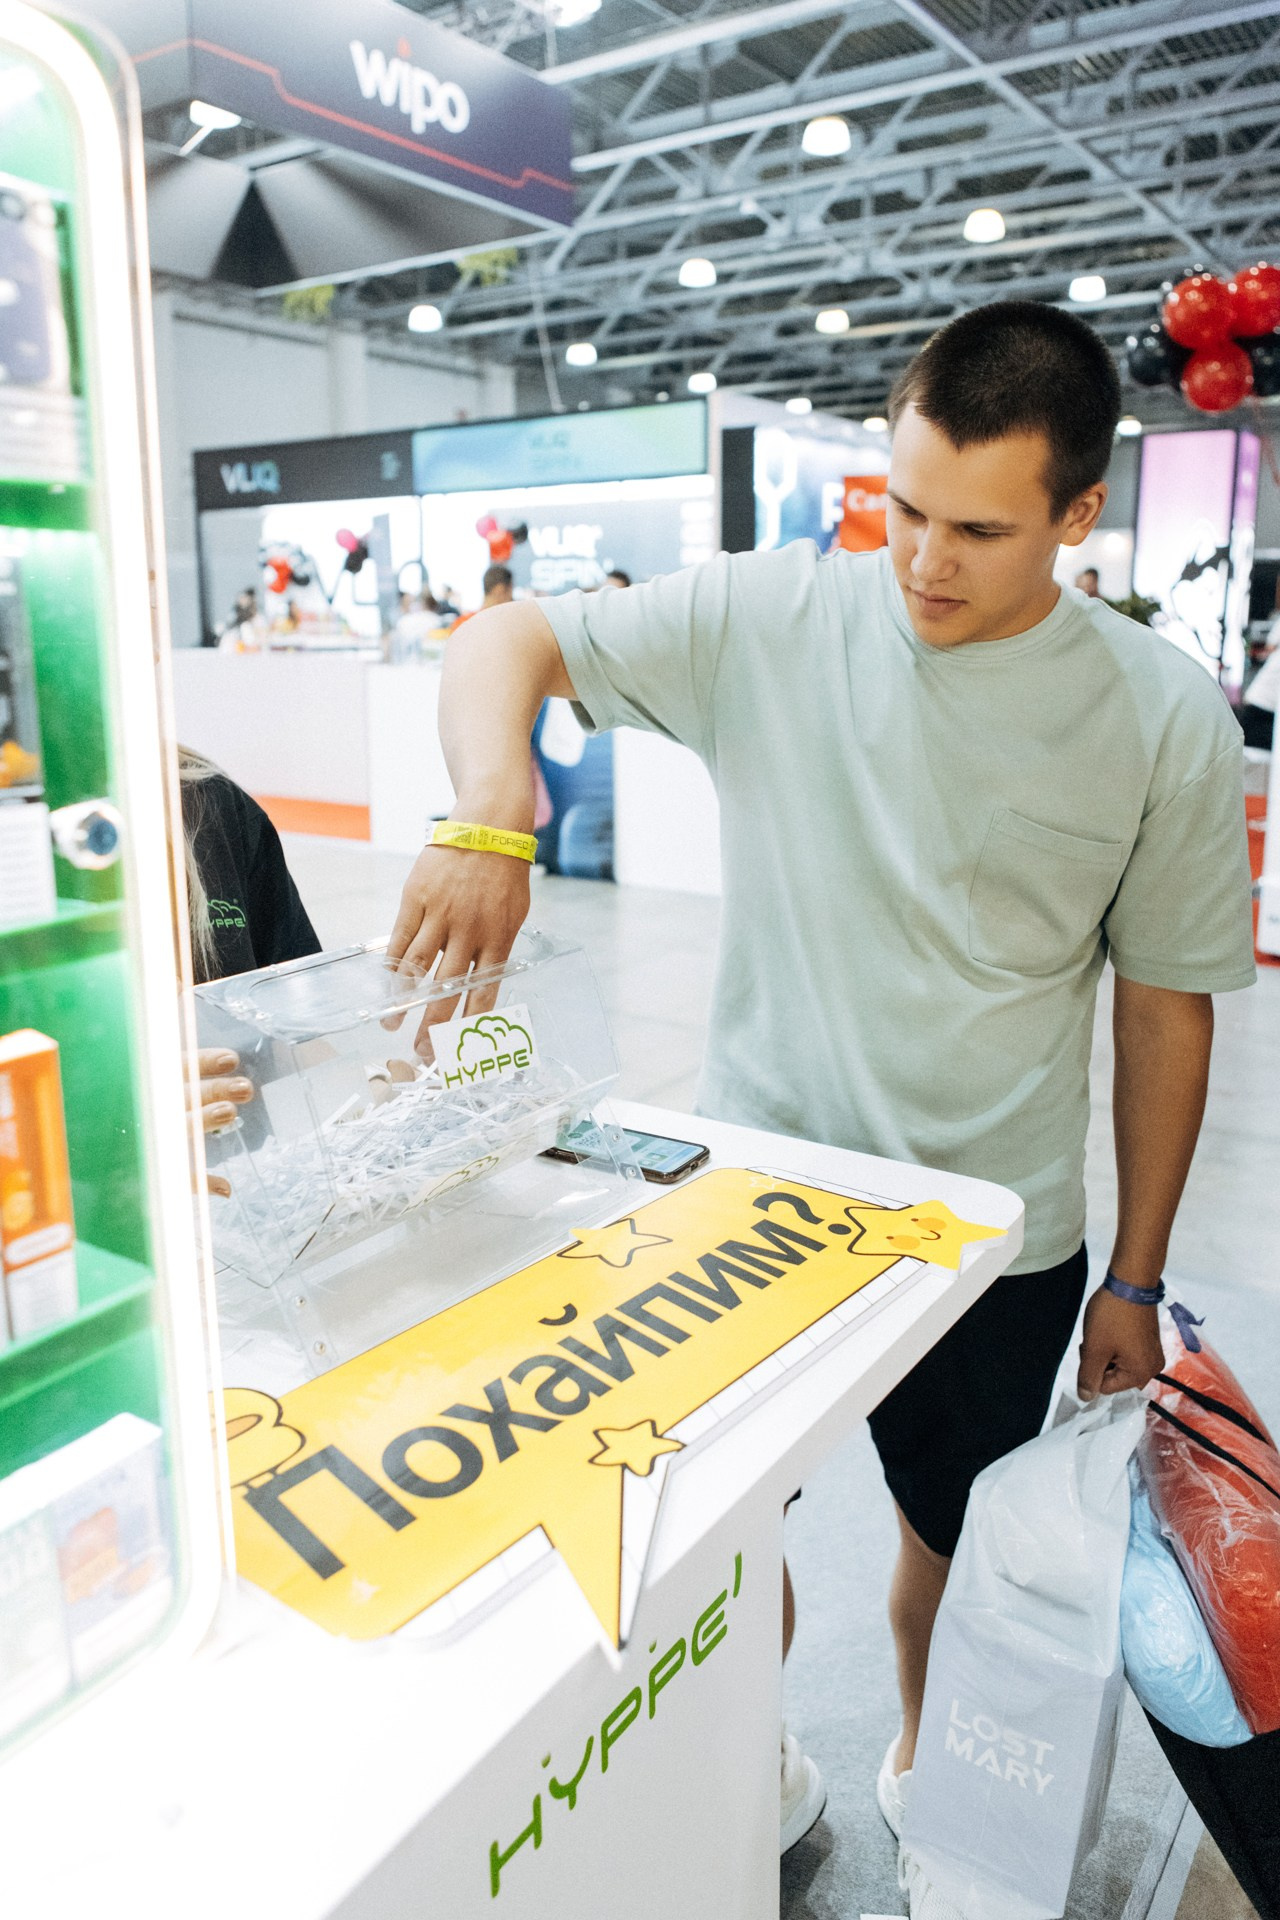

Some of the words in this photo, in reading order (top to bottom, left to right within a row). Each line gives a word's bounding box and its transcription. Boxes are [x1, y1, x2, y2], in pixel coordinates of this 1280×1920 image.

[349, 36, 470, 134] wipo
[444, 1048, 530, 1089] HYPPE
[243, 1191, 852, 1581] Похайпим?
[489, 1588, 729, 1899] HYPPE
[944, 1726, 1055, 1796] MARY
[949, 1698, 1055, 1766] LOST
